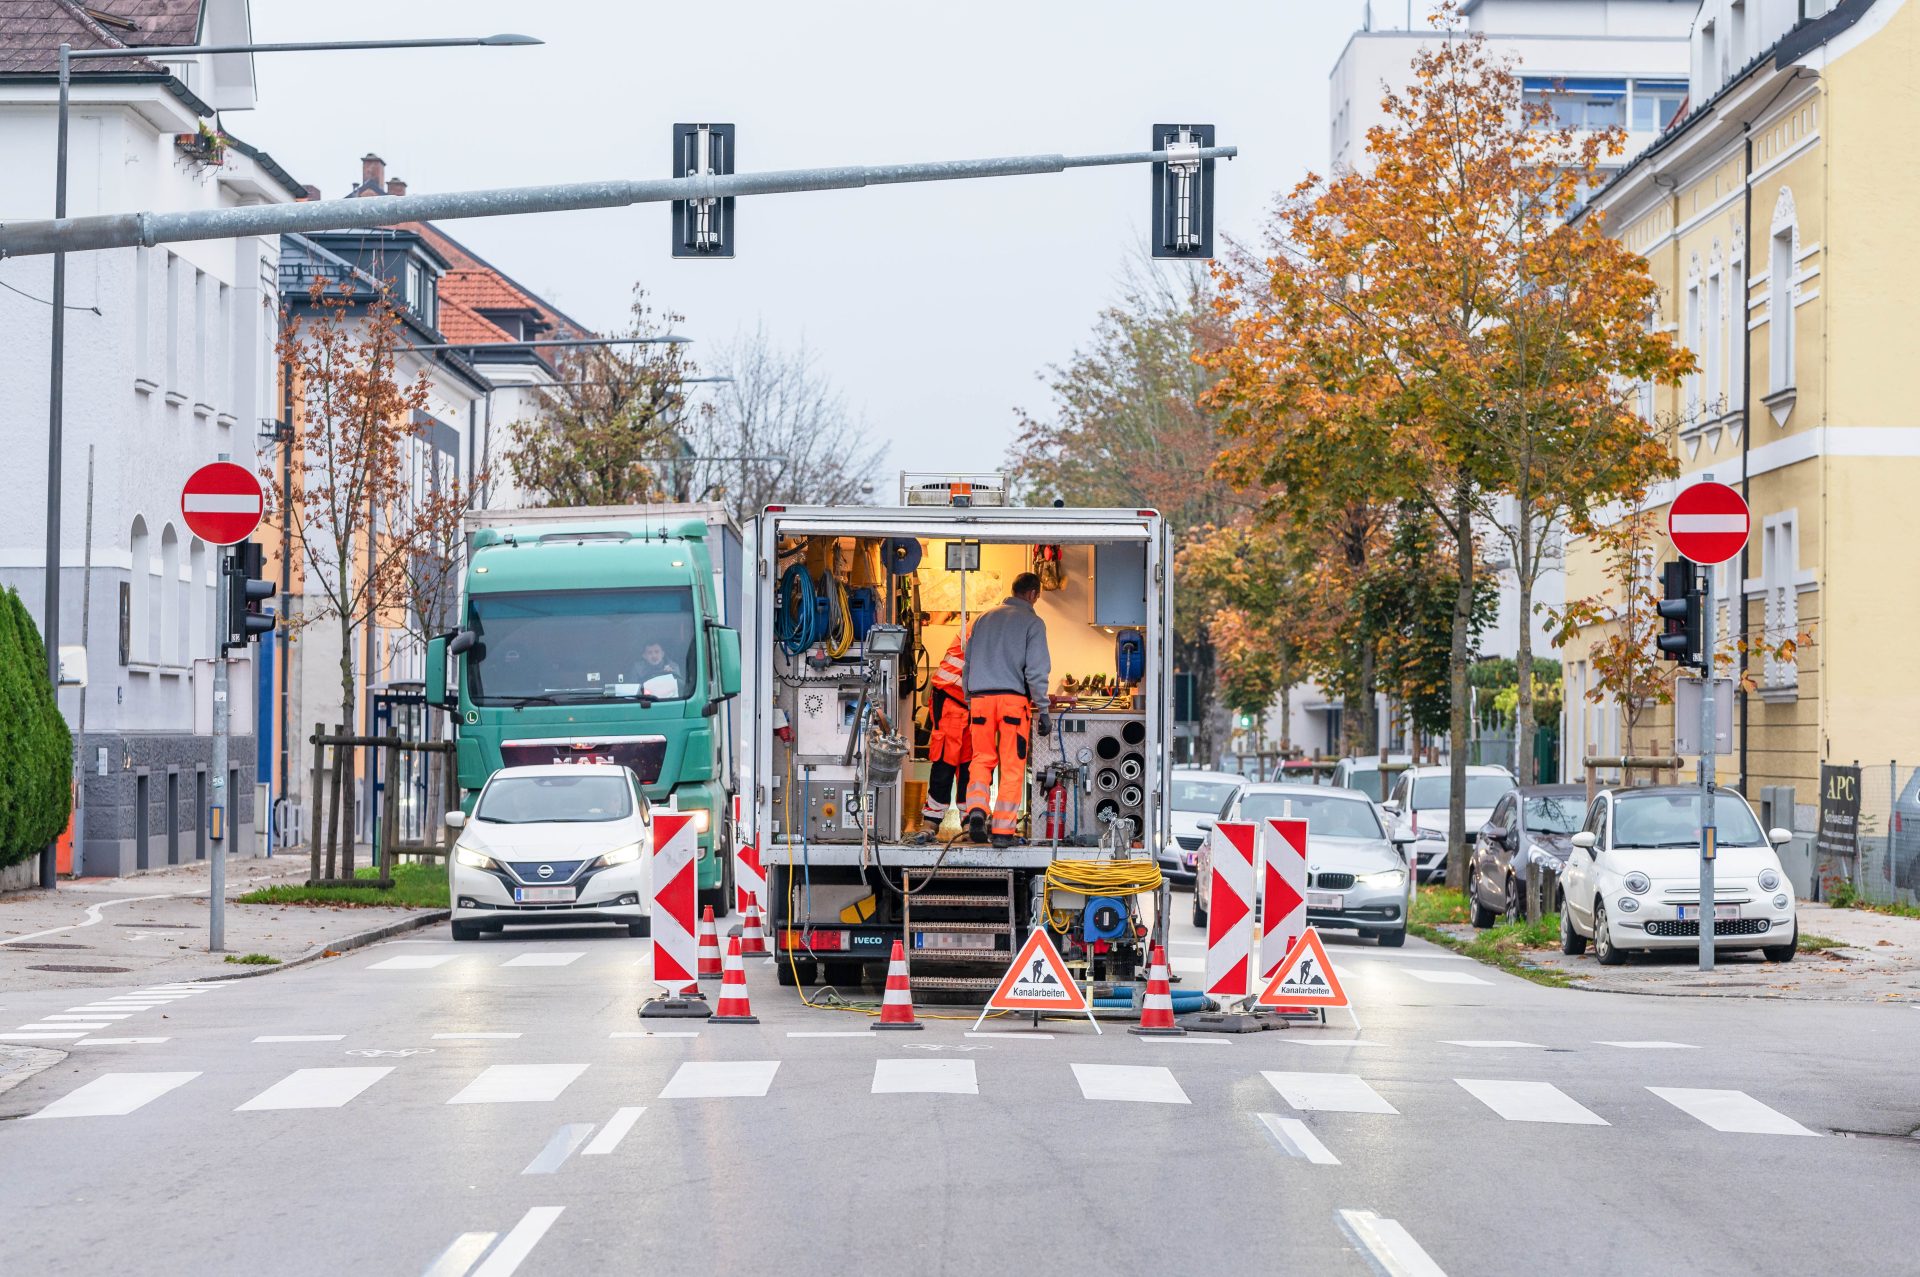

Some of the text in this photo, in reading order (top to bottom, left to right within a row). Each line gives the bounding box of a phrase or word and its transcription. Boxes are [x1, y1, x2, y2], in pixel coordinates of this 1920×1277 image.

[469, 712, 475, 722] L
[1826, 774, 1855, 801] APC
[854, 936, 883, 944] IVECO
[1013, 987, 1065, 998] Kanalarbeiten
[1281, 986, 1330, 996] Kanalarbeiten
